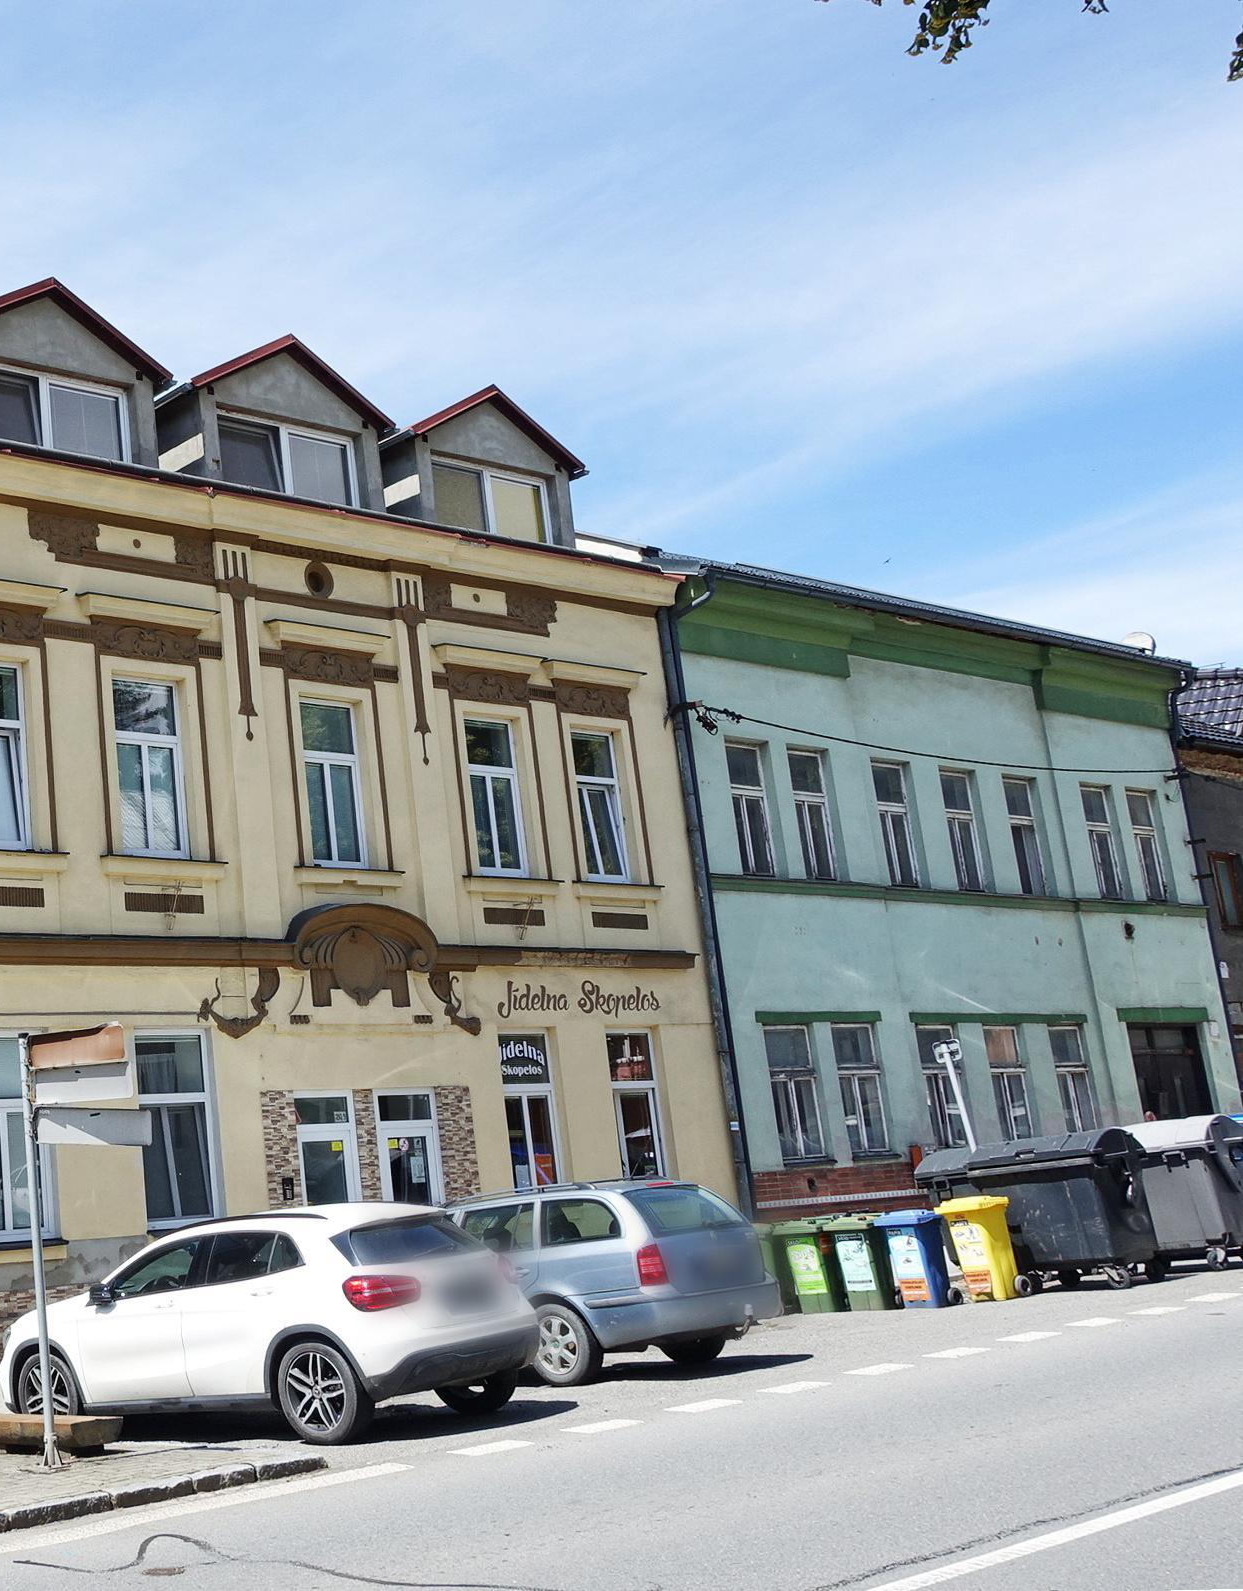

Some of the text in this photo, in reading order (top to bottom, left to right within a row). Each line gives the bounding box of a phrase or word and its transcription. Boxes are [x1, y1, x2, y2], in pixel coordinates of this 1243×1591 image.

[497, 980, 661, 1019] Jídelna Skopelos
[501, 1064, 543, 1077] Skopelos
